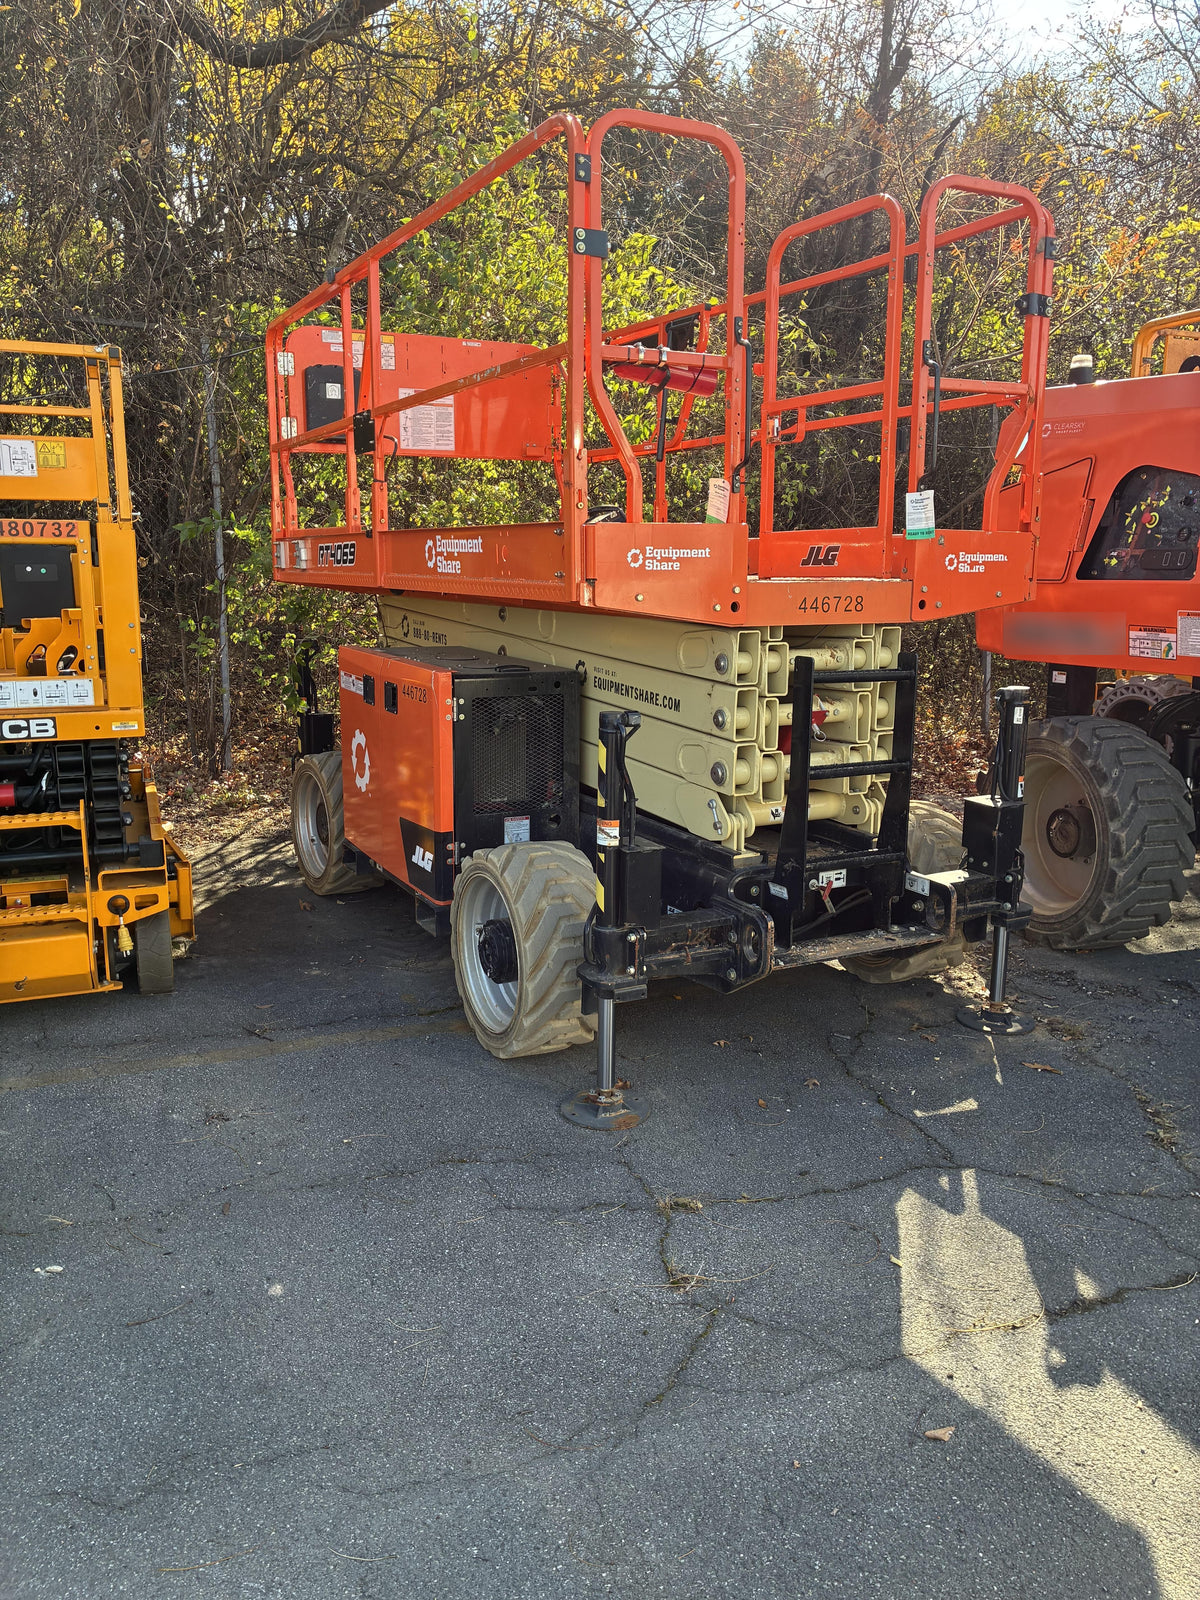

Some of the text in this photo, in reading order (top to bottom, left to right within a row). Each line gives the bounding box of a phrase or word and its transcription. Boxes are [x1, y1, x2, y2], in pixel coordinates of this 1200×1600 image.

[1053, 422, 1086, 430] CLEARSKY
[317, 541, 356, 567] RT4069
[435, 535, 483, 556] Equipment
[645, 546, 711, 560] Equipment
[436, 556, 461, 574] Share
[645, 559, 680, 571] Share
[800, 544, 841, 567] JLG
[798, 595, 864, 613] 446728
[413, 627, 447, 646] 888-80-RENTS
[402, 684, 427, 703] 446728
[593, 676, 681, 712] EQUIPMENTSHARE.COM
[411, 845, 434, 873] JLG
